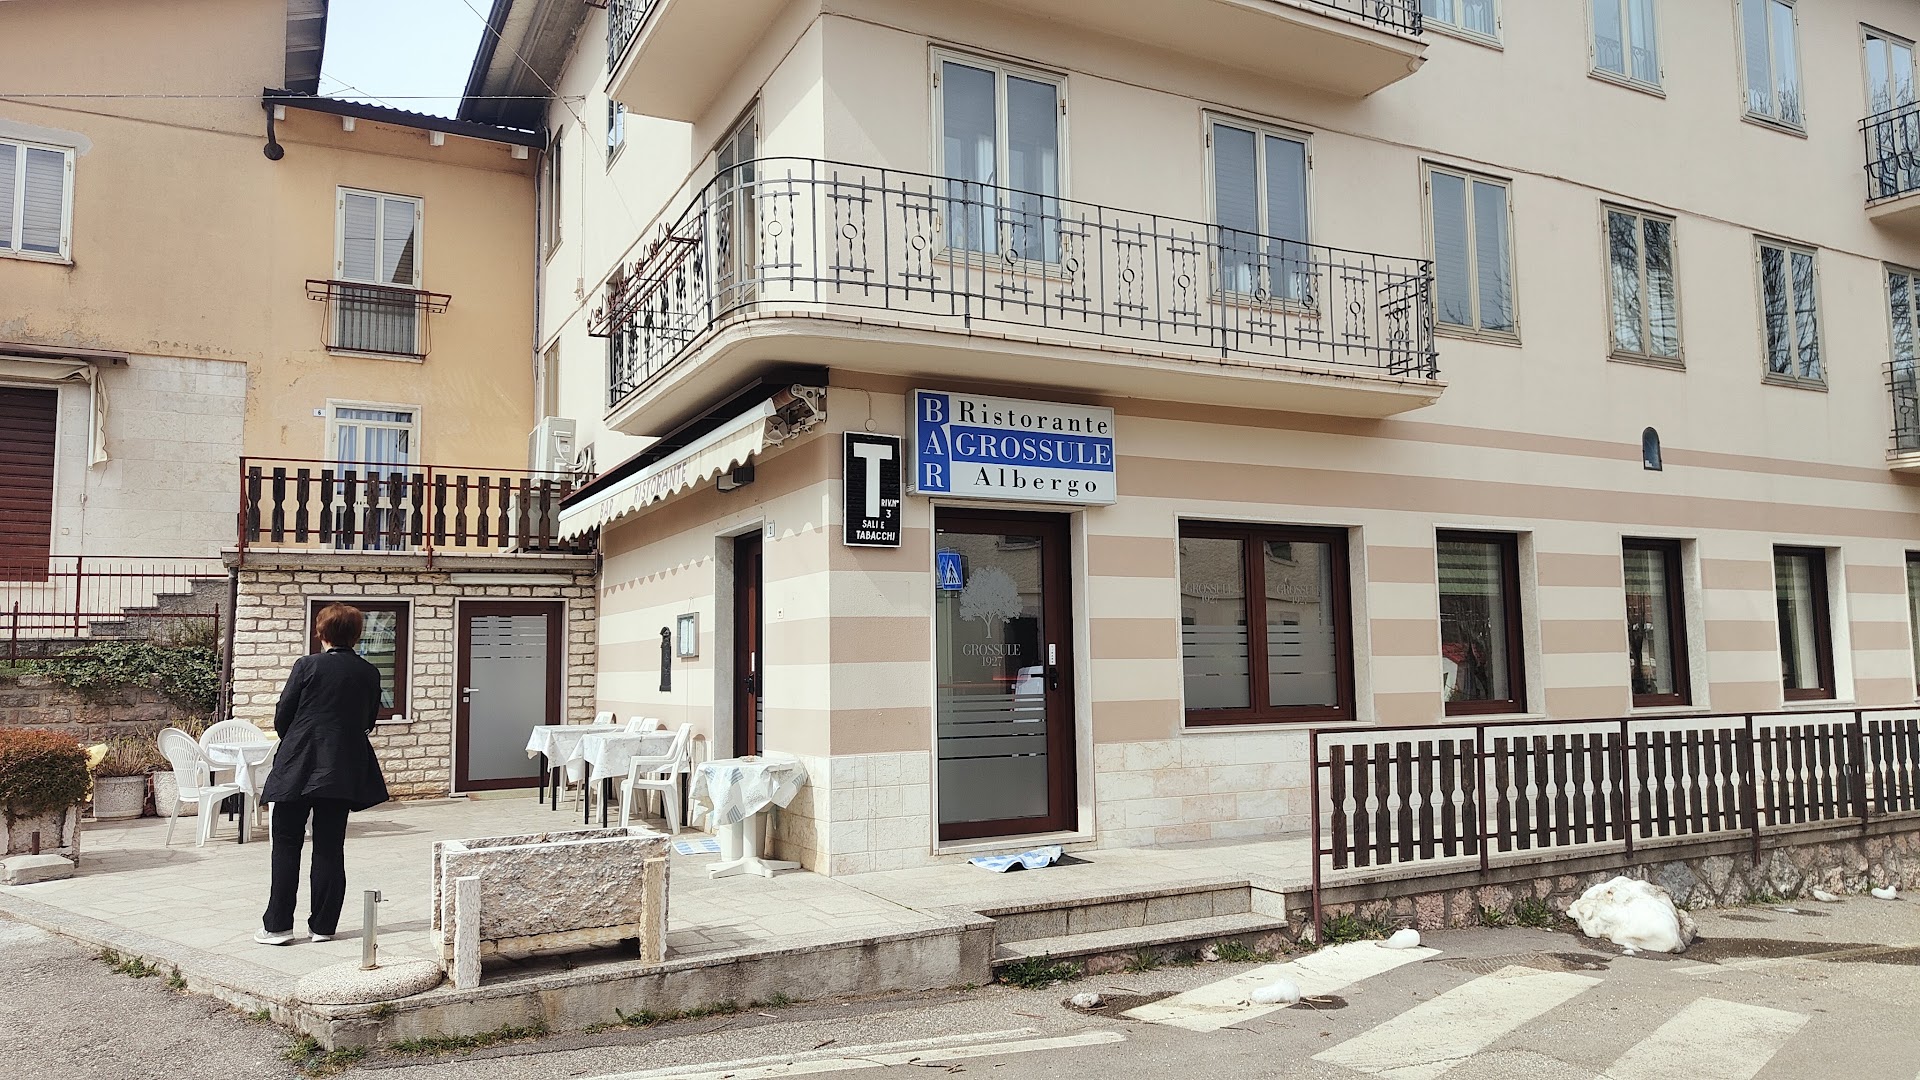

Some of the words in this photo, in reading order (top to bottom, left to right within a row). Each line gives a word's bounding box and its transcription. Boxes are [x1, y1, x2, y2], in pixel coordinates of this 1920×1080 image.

[958, 400, 1108, 434] Ristorante
[923, 397, 945, 488] BAR
[955, 432, 1112, 466] GROSSULE
[634, 461, 687, 503] RISTORANTE
[853, 443, 893, 518] T
[973, 466, 1097, 497] Albergo
[862, 519, 879, 529] SALI
[880, 521, 885, 529] E
[885, 509, 892, 518] 3
[856, 530, 896, 541] TABACCHI
[962, 643, 1021, 656] GROSSULE
[981, 656, 1003, 667] 1927
